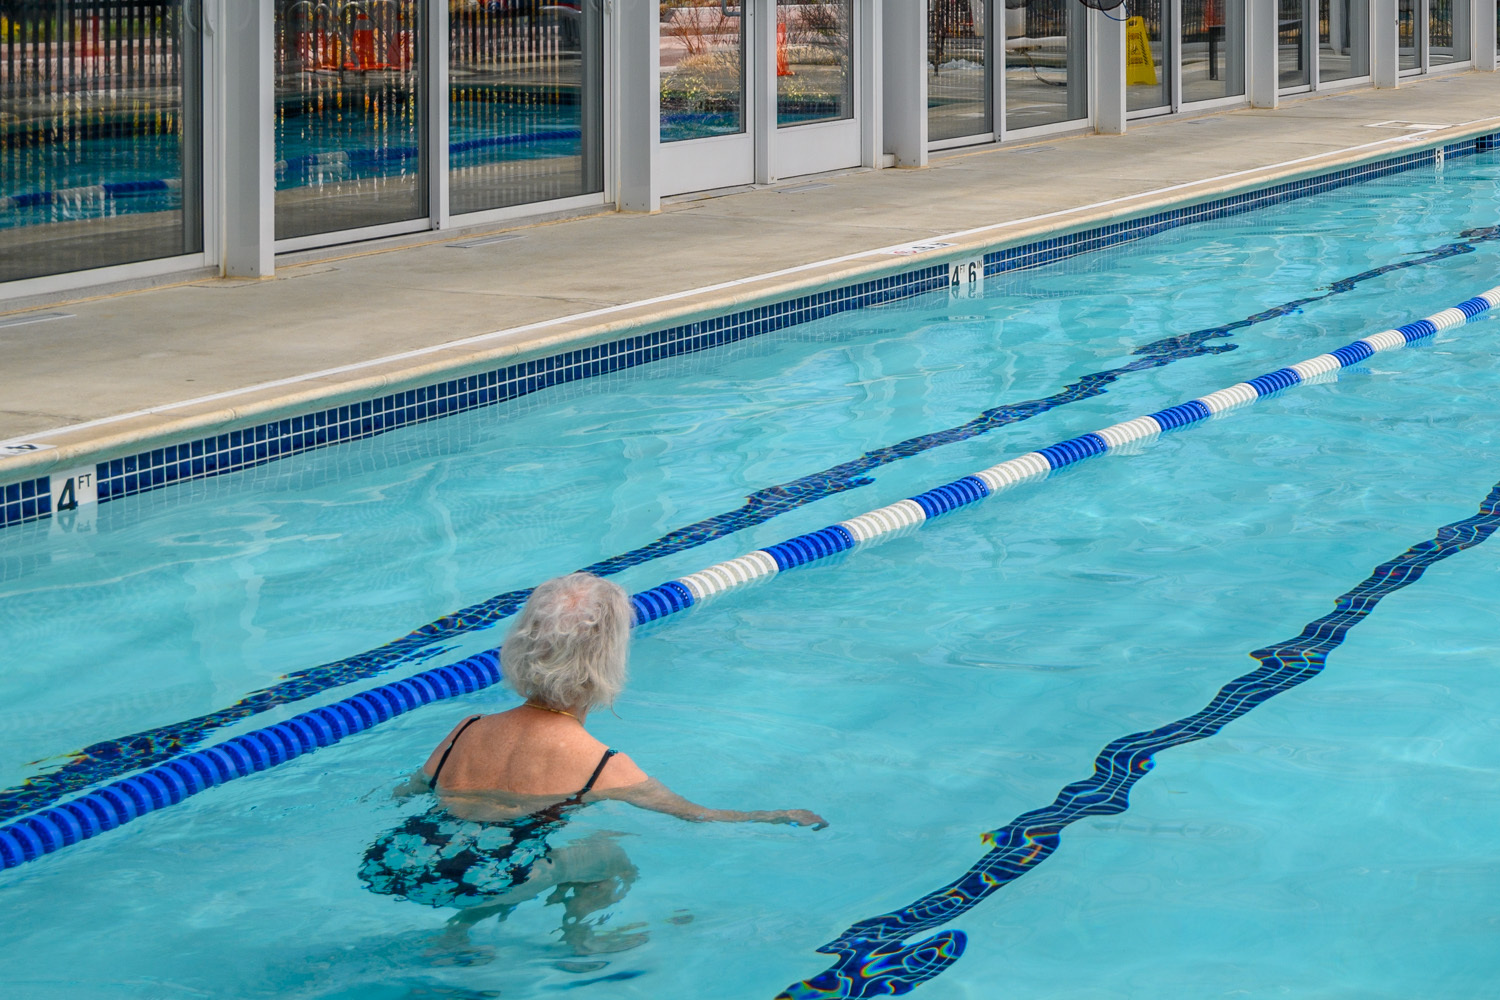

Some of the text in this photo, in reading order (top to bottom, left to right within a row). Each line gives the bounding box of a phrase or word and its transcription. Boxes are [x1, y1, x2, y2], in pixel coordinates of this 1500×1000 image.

[1436, 149, 1441, 164] 5
[951, 260, 983, 286] 4 FT 6 IN
[57, 473, 92, 512] 4 FT
